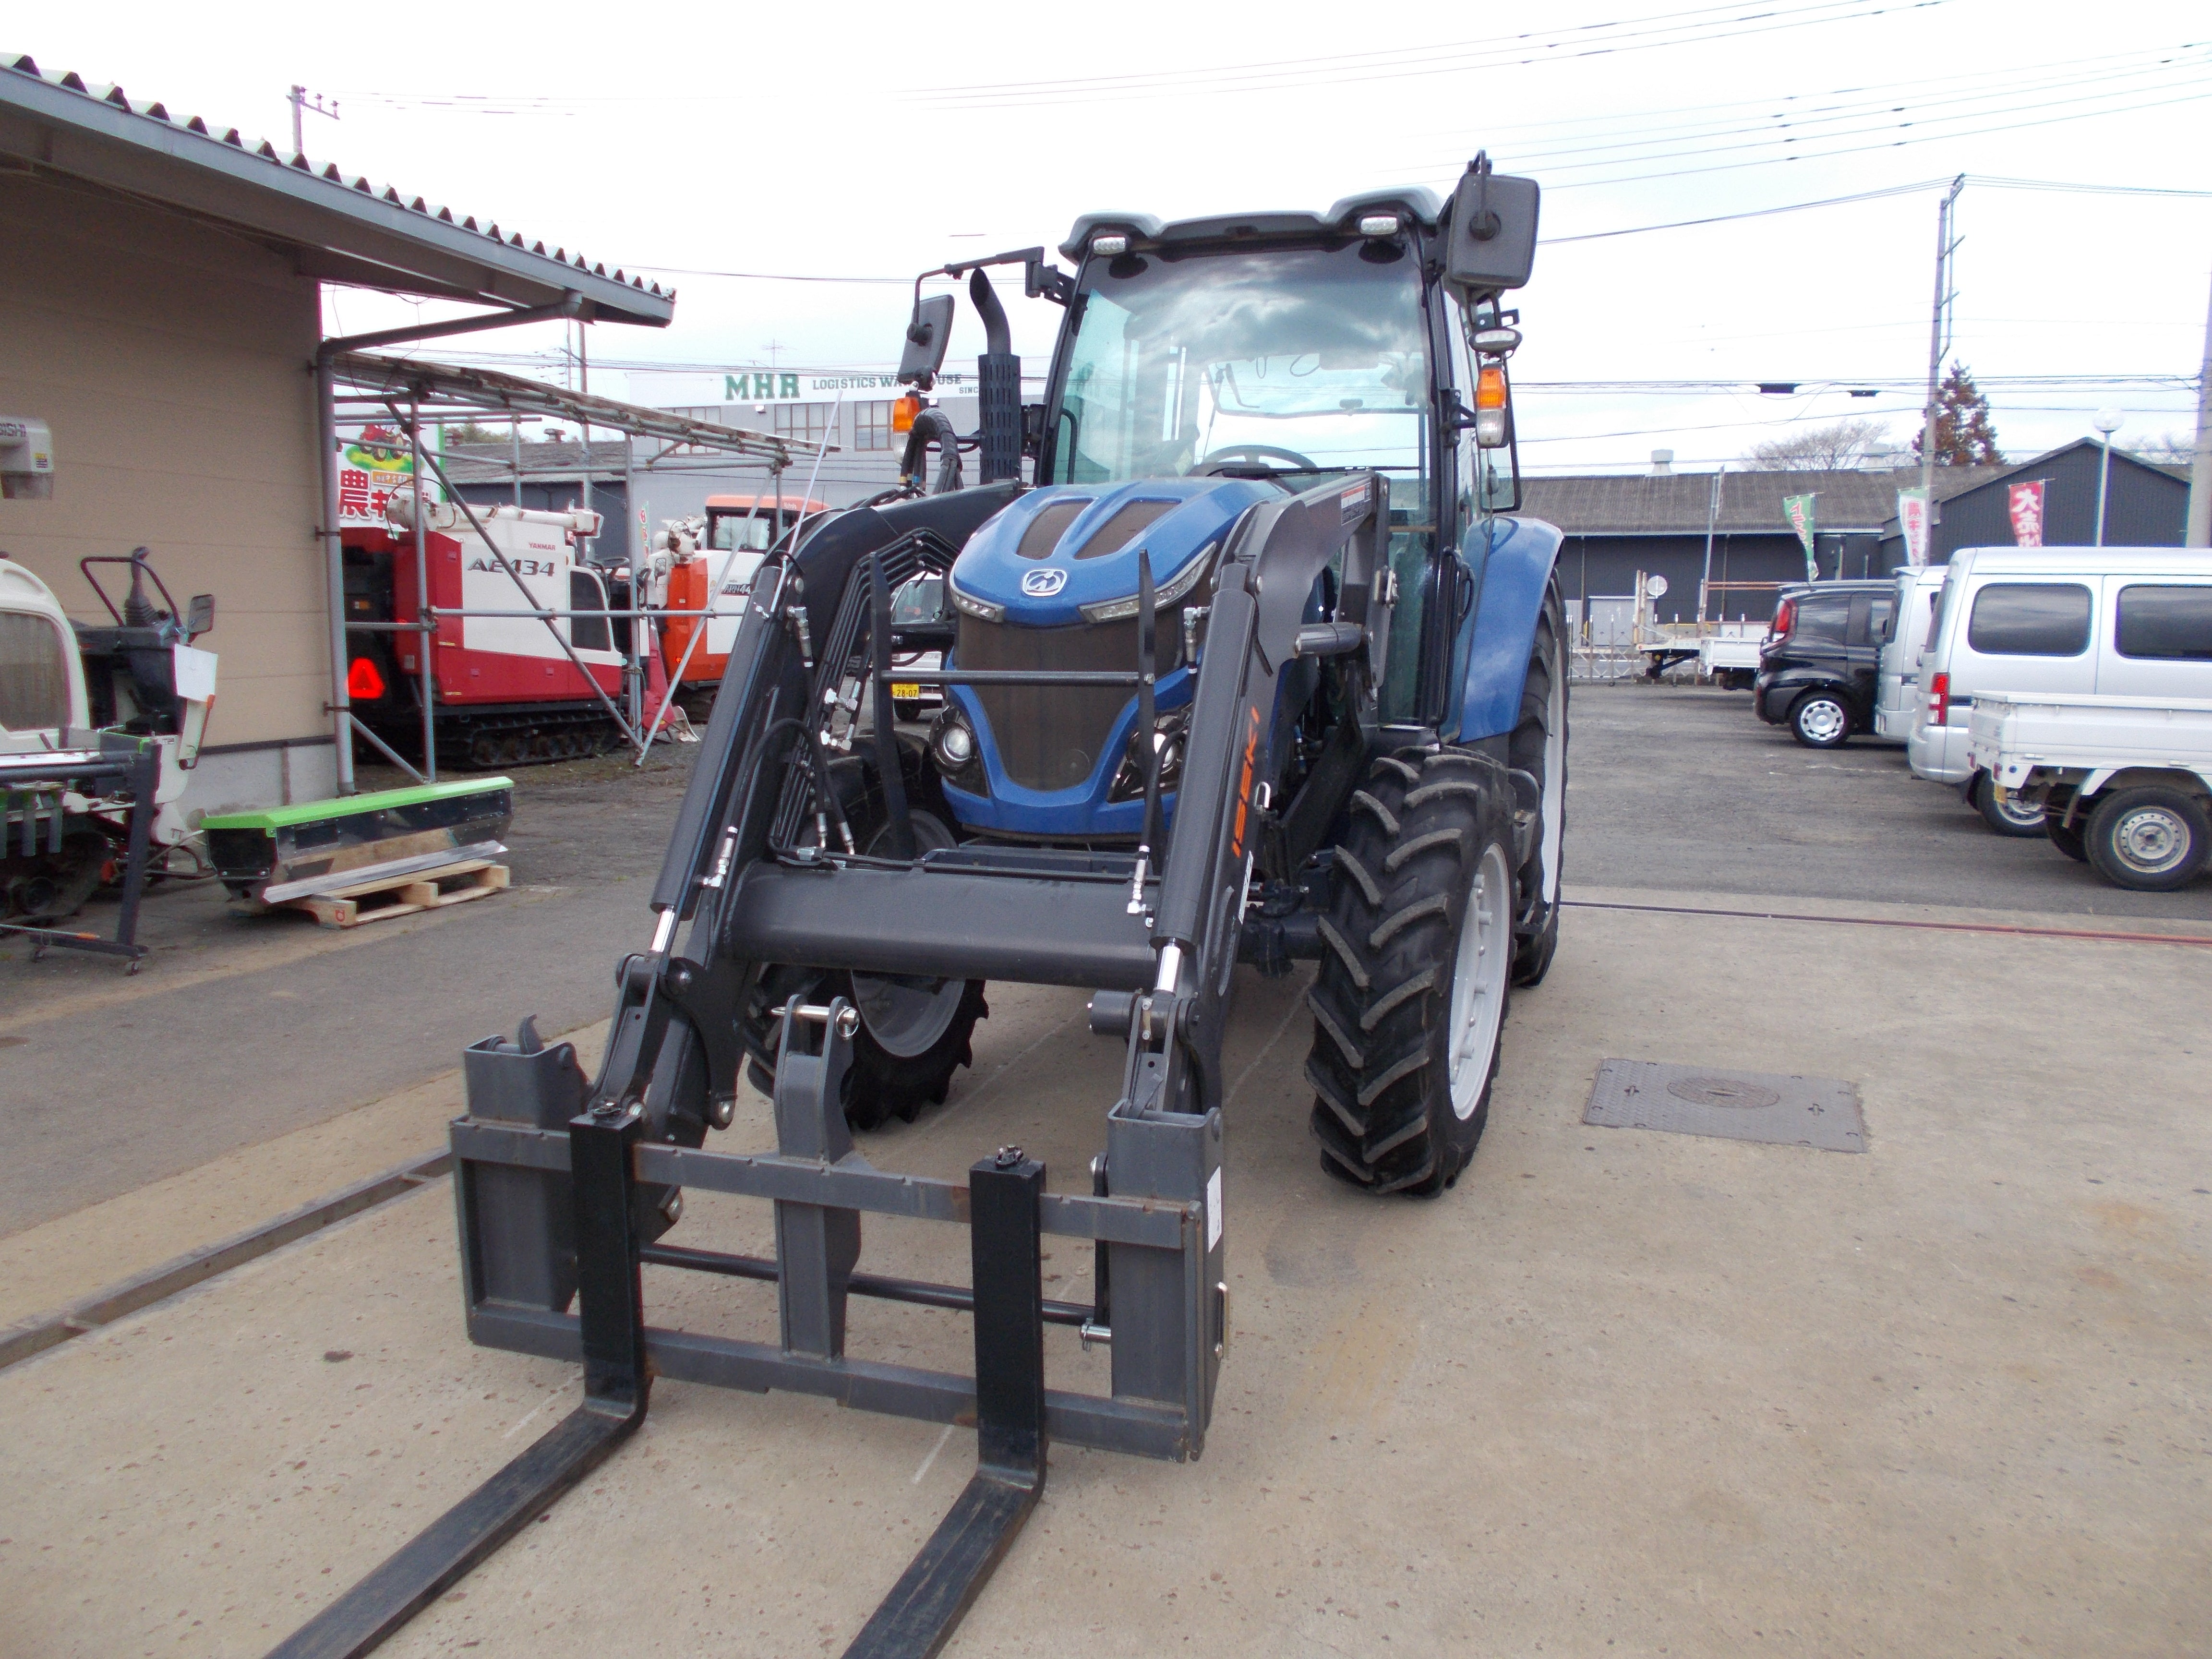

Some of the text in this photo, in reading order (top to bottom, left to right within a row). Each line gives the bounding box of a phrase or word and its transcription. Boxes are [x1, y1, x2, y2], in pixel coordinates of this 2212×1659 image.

[725, 373, 800, 400] MHR
[813, 374, 962, 390] LOGISTICS WAUSE
[529, 542, 556, 551] YANMAR
[468, 558, 555, 577] AE434
[1232, 706, 1260, 858] ISEKI
